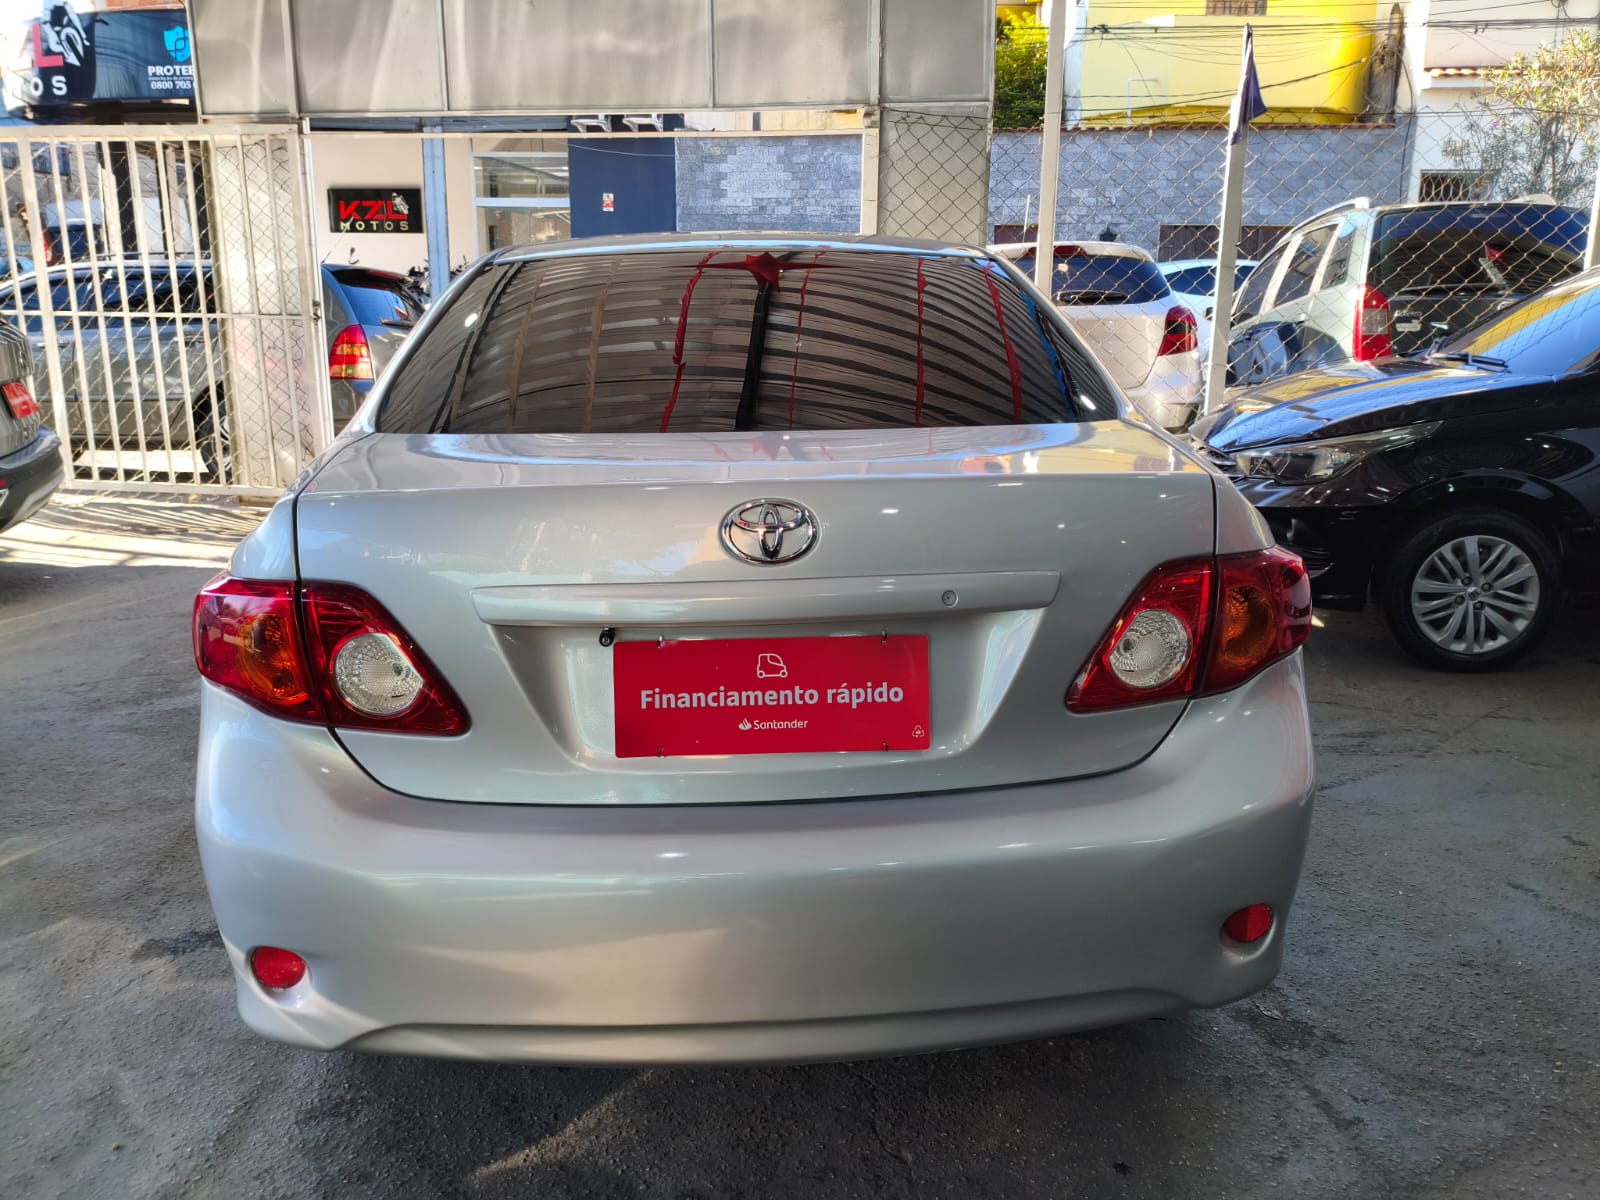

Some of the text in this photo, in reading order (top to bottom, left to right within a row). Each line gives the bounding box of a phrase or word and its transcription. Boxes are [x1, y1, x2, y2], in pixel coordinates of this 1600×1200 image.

[151, 80, 192, 89] 0800 705
[339, 200, 408, 220] KZL
[340, 220, 409, 231] MOTOS
[640, 682, 904, 709] Financiamento rápido
[753, 719, 808, 730] Santander
